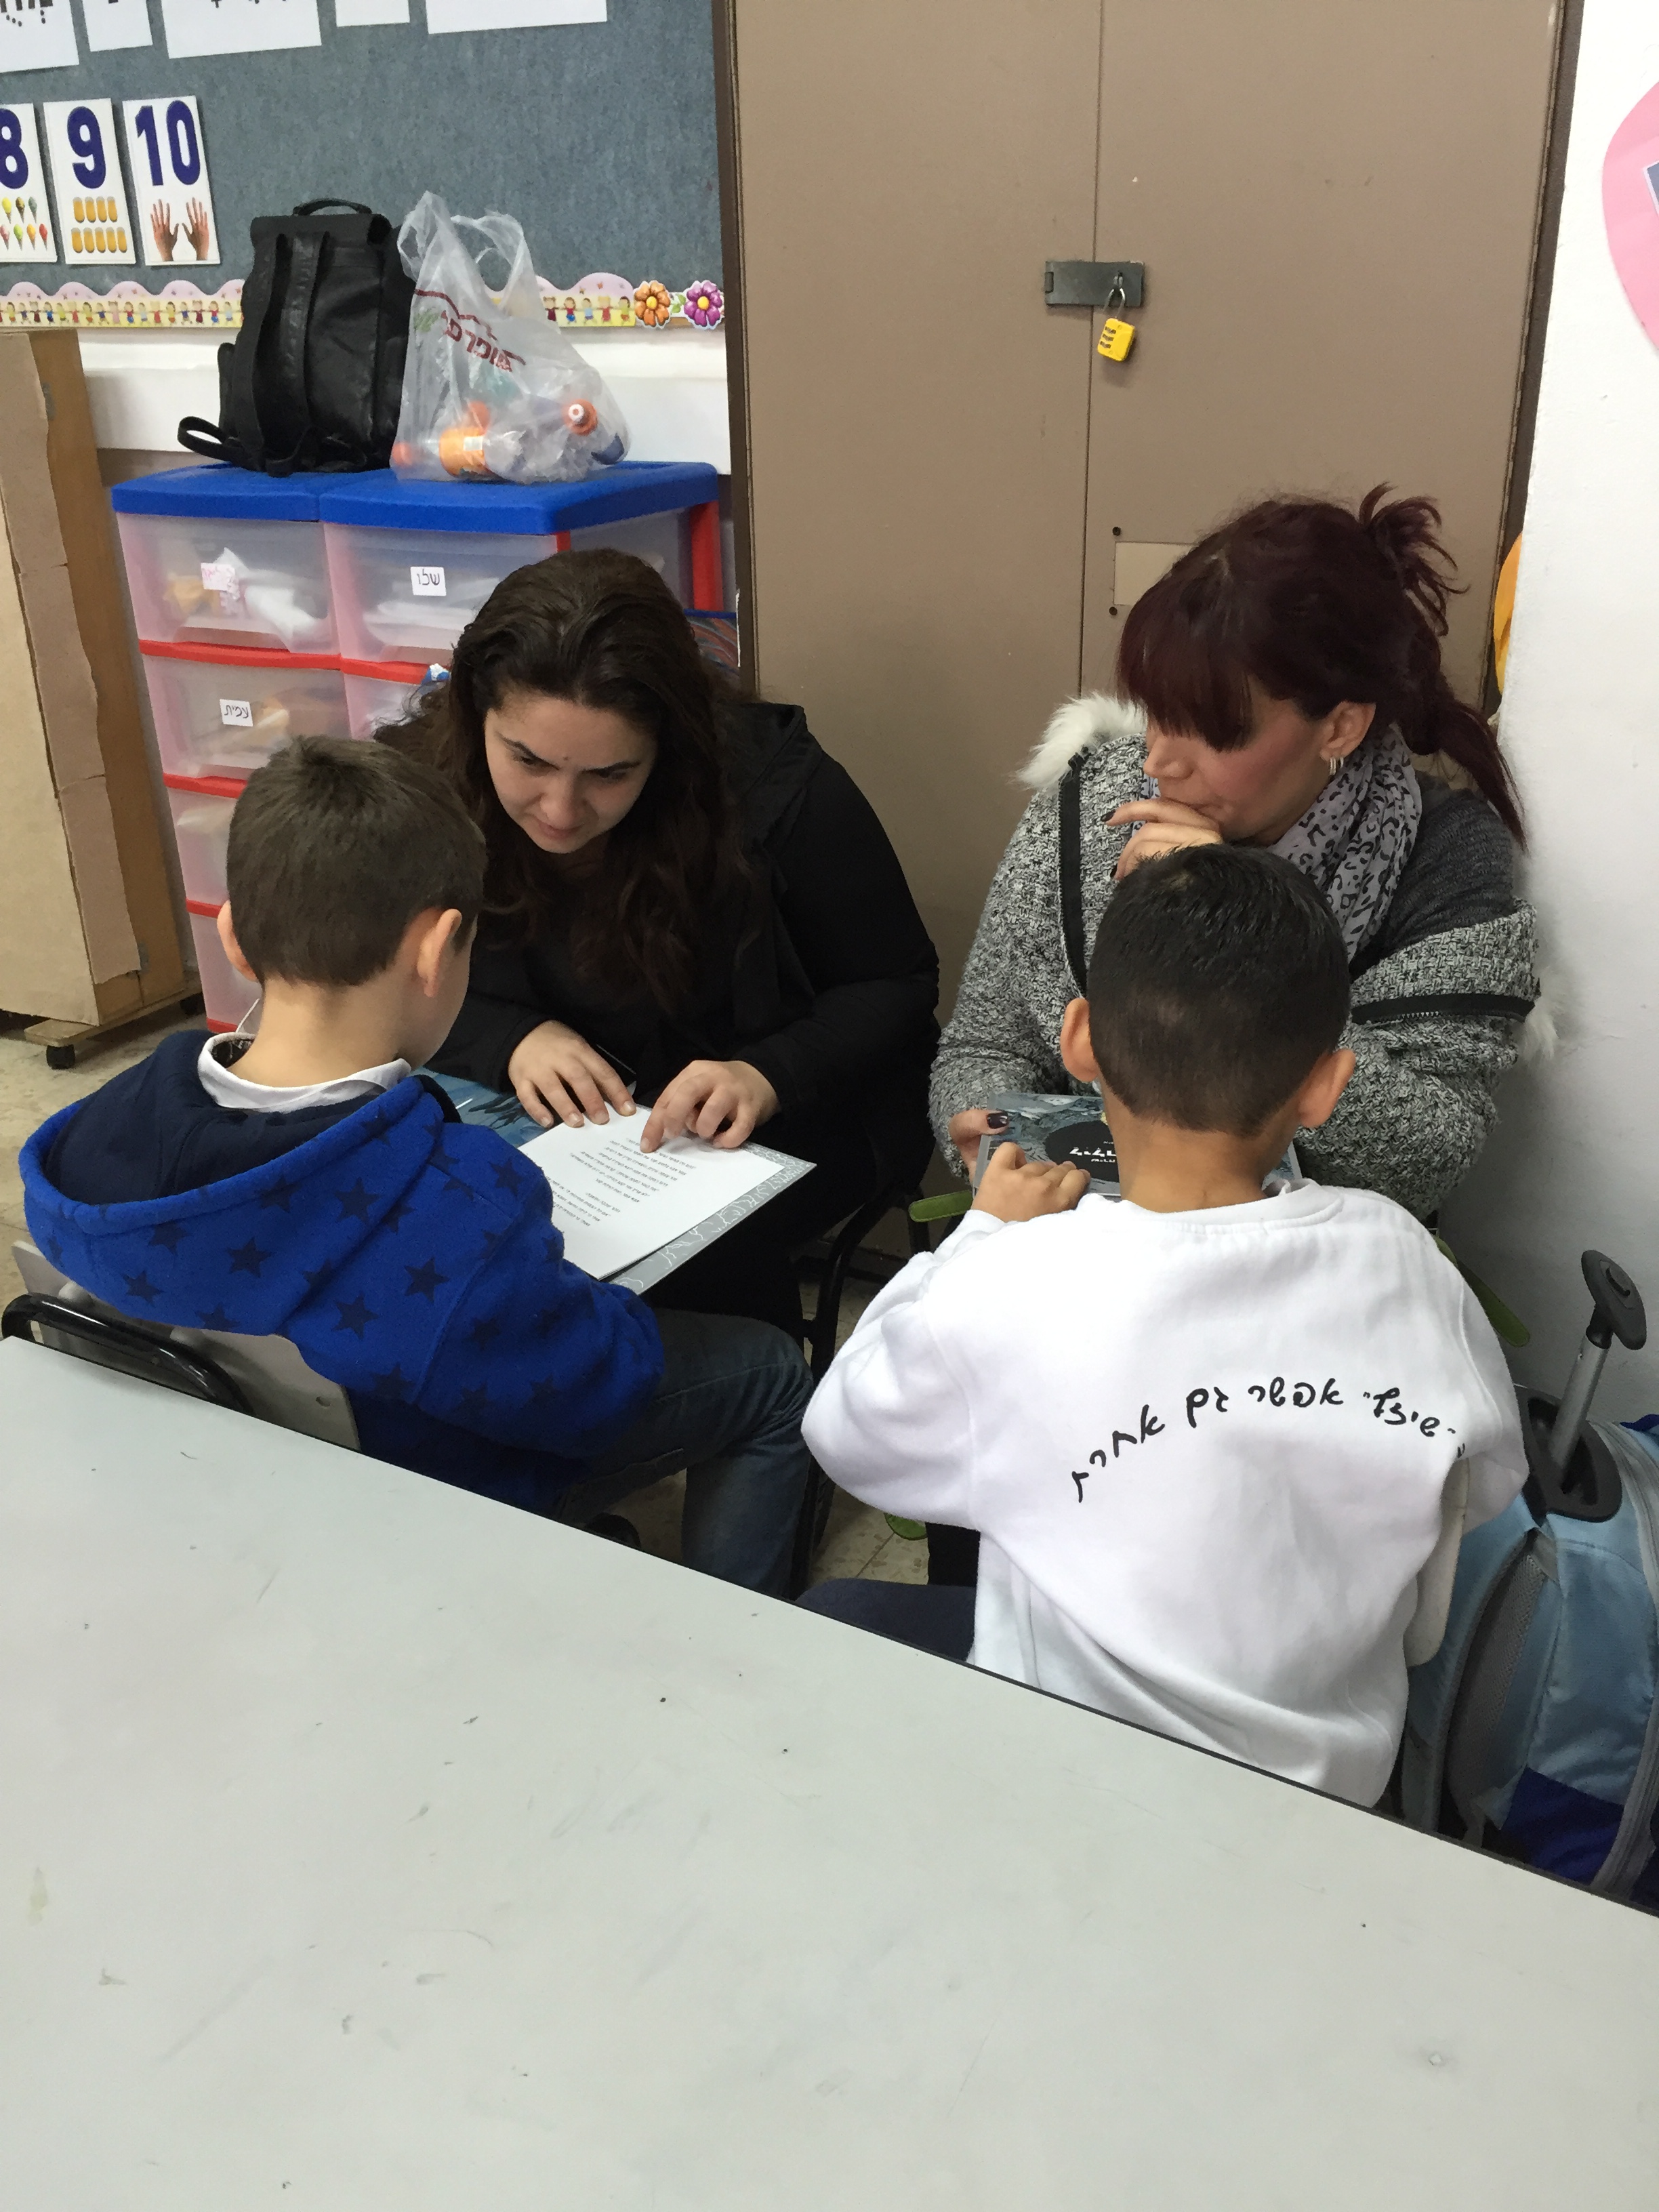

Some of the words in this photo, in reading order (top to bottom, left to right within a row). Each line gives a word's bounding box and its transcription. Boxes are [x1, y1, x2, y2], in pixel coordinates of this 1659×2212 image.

[66, 106, 107, 190] 9
[134, 100, 201, 187] 10
[1185, 1386, 1229, 1429] גם
[1248, 1376, 1344, 1408] אפשר
[1071, 1404, 1166, 1504] אחרת
